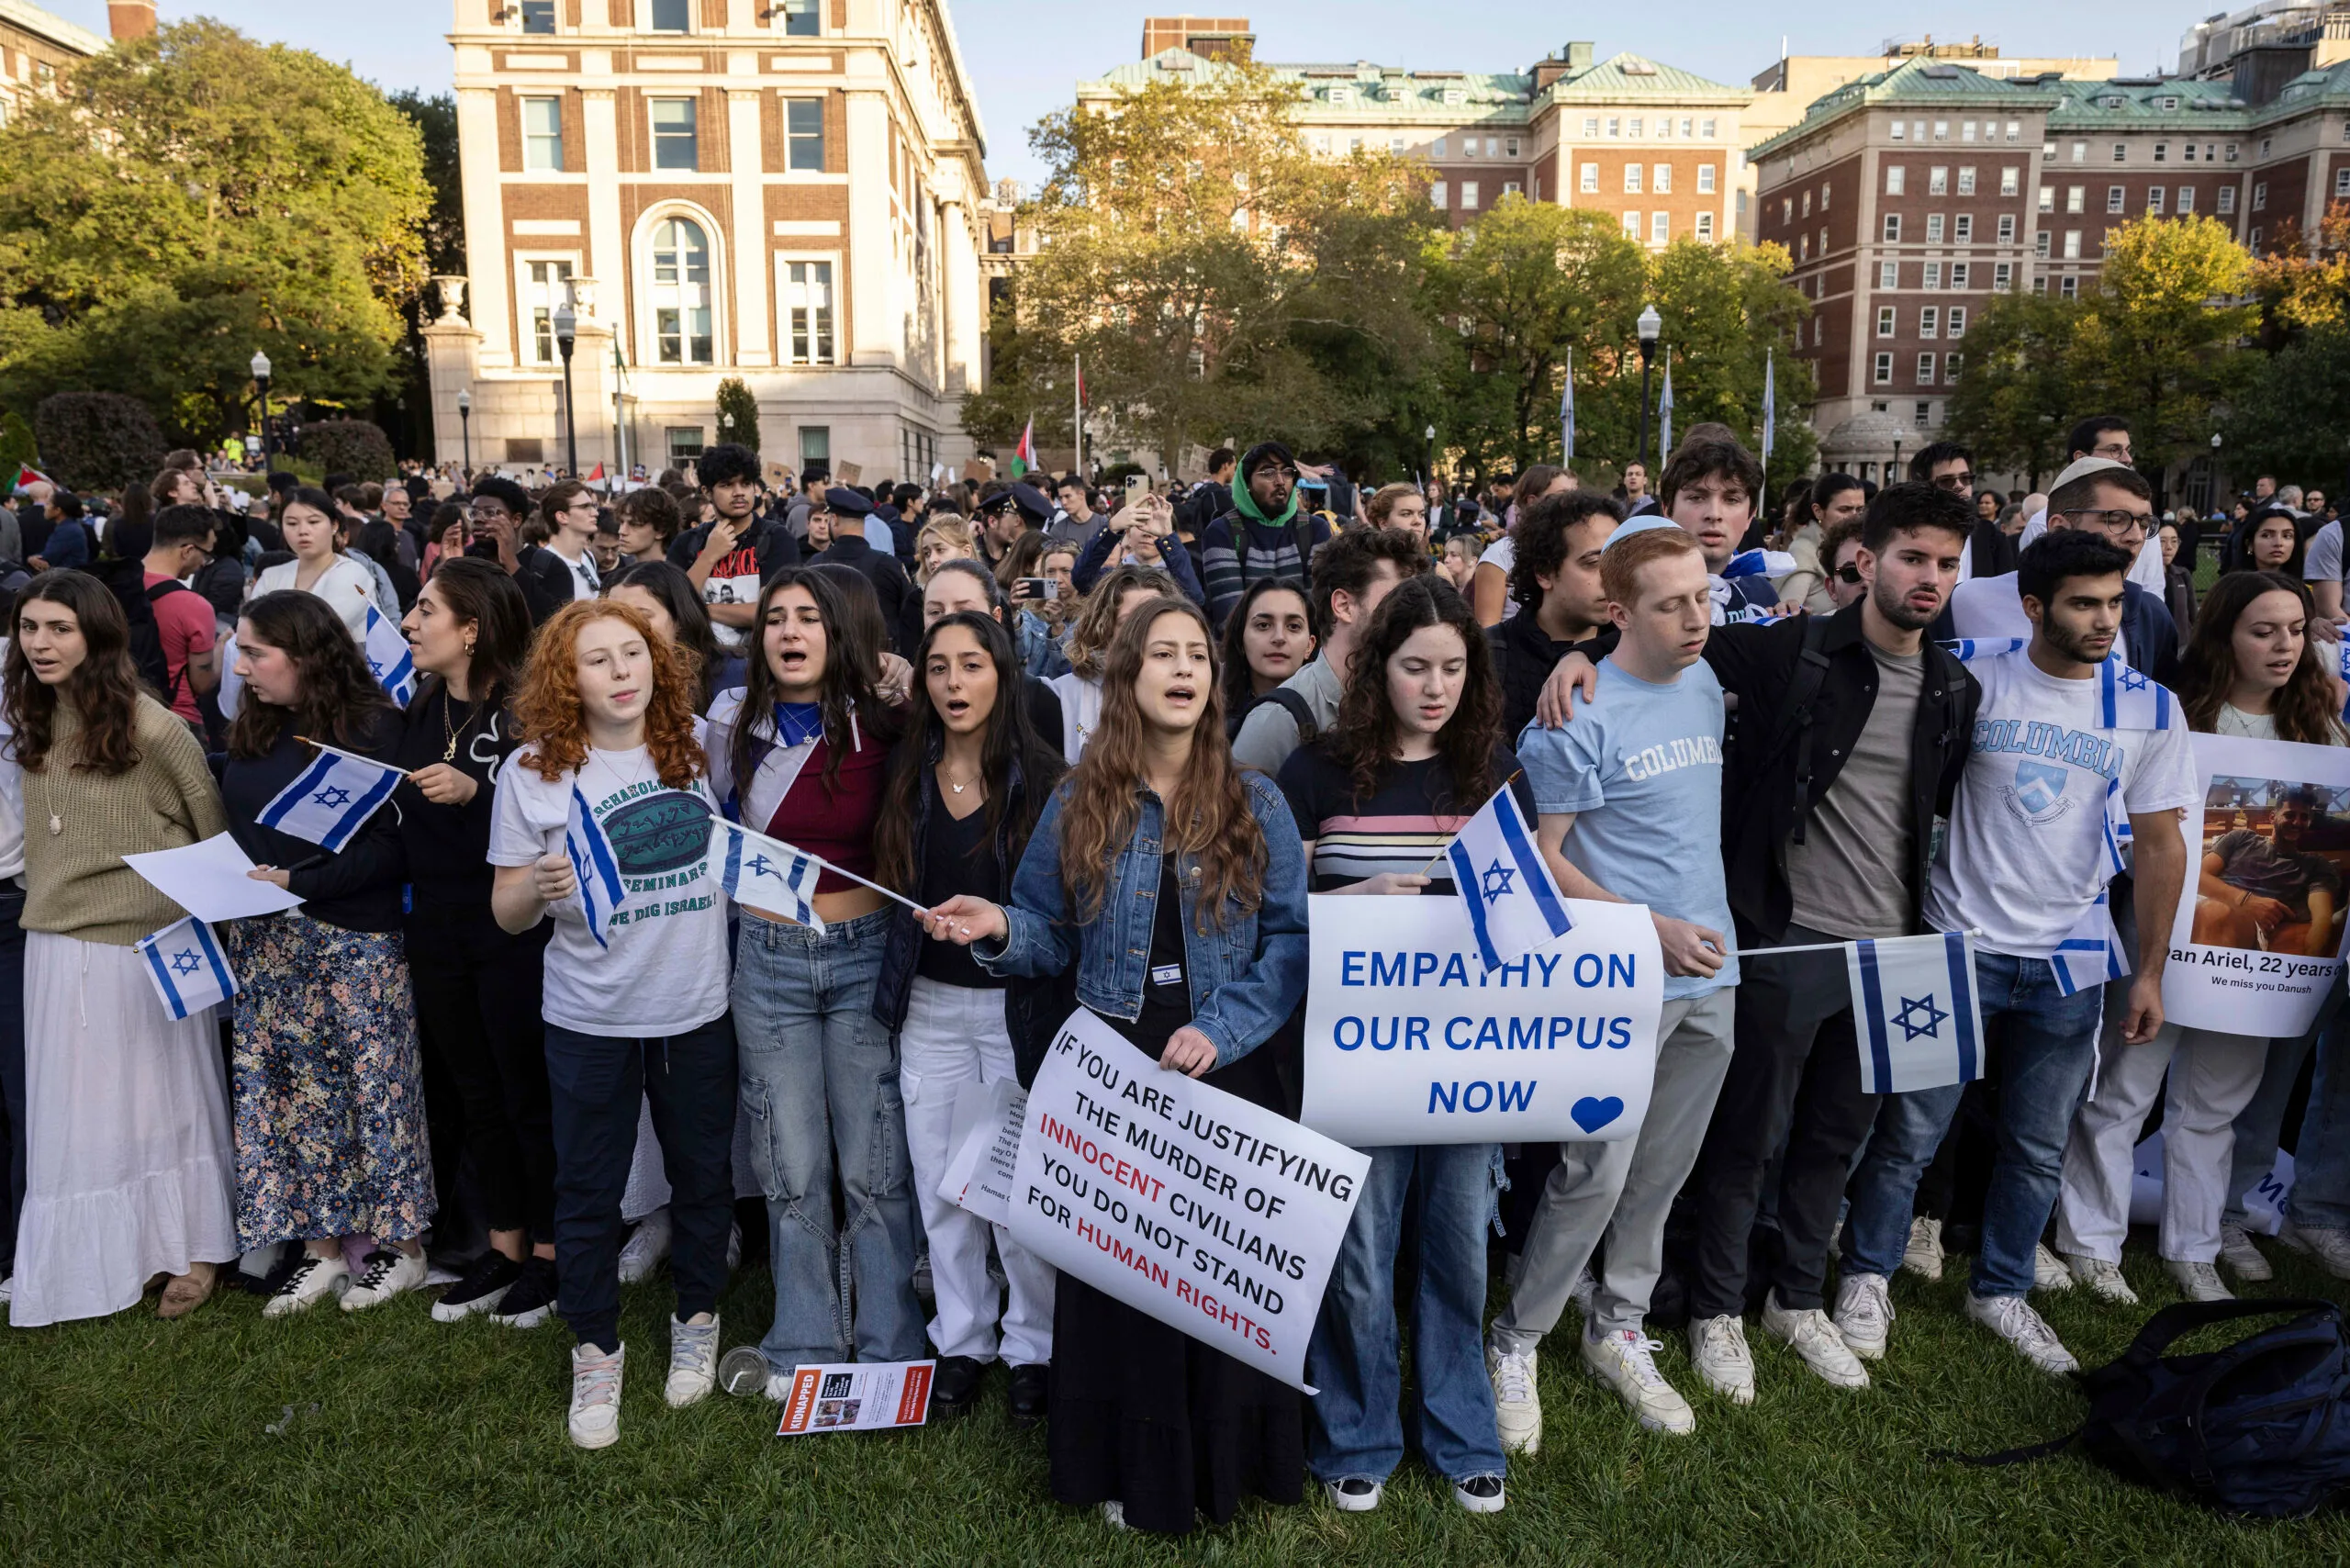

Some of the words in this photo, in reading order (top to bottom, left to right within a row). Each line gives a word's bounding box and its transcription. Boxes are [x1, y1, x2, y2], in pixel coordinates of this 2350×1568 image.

[1625, 736, 1724, 782] COLUMBI
[622, 861, 708, 892] SEMINARS
[634, 903, 660, 923] DIG
[1573, 953, 1636, 988] ON
[2166, 947, 2197, 964] an
[2202, 950, 2254, 974] Ariel,
[2259, 957, 2282, 973] 22
[2285, 962, 2333, 979] years
[2211, 976, 2228, 985] We
[2230, 979, 2254, 989] miss
[2255, 983, 2275, 992] you
[2277, 983, 2311, 994] Danush
[1333, 1016, 1430, 1051] OUR
[1444, 1016, 1633, 1051] CAMPUS
[1427, 1081, 1538, 1114] NOW
[1056, 1030, 1078, 1056] IF
[1077, 1043, 1120, 1090] YOU
[1121, 1080, 1176, 1121] ARE
[1178, 1109, 1354, 1203] JUSTIFYING
[991, 1146, 1005, 1156] say
[999, 1136, 1012, 1147] The
[1076, 1091, 1121, 1137] THE
[1125, 1122, 1237, 1202] MURDER
[1244, 1187, 1286, 1219] OF
[990, 1155, 1011, 1168] there
[980, 1183, 1006, 1200] Hamas
[1040, 1113, 1166, 1204] INNOCENT
[1169, 1193, 1307, 1281] CIVILIANS
[1043, 1152, 1088, 1198] YOU
[1093, 1188, 1128, 1224] DO
[1135, 1213, 1189, 1259] NOT
[1192, 1249, 1284, 1316] STAND
[1027, 1185, 1071, 1230] FOR
[1077, 1217, 1169, 1289] HUMAN
[1176, 1278, 1277, 1355] RIGHTS.
[789, 1374, 814, 1430] KIDNAPPED
